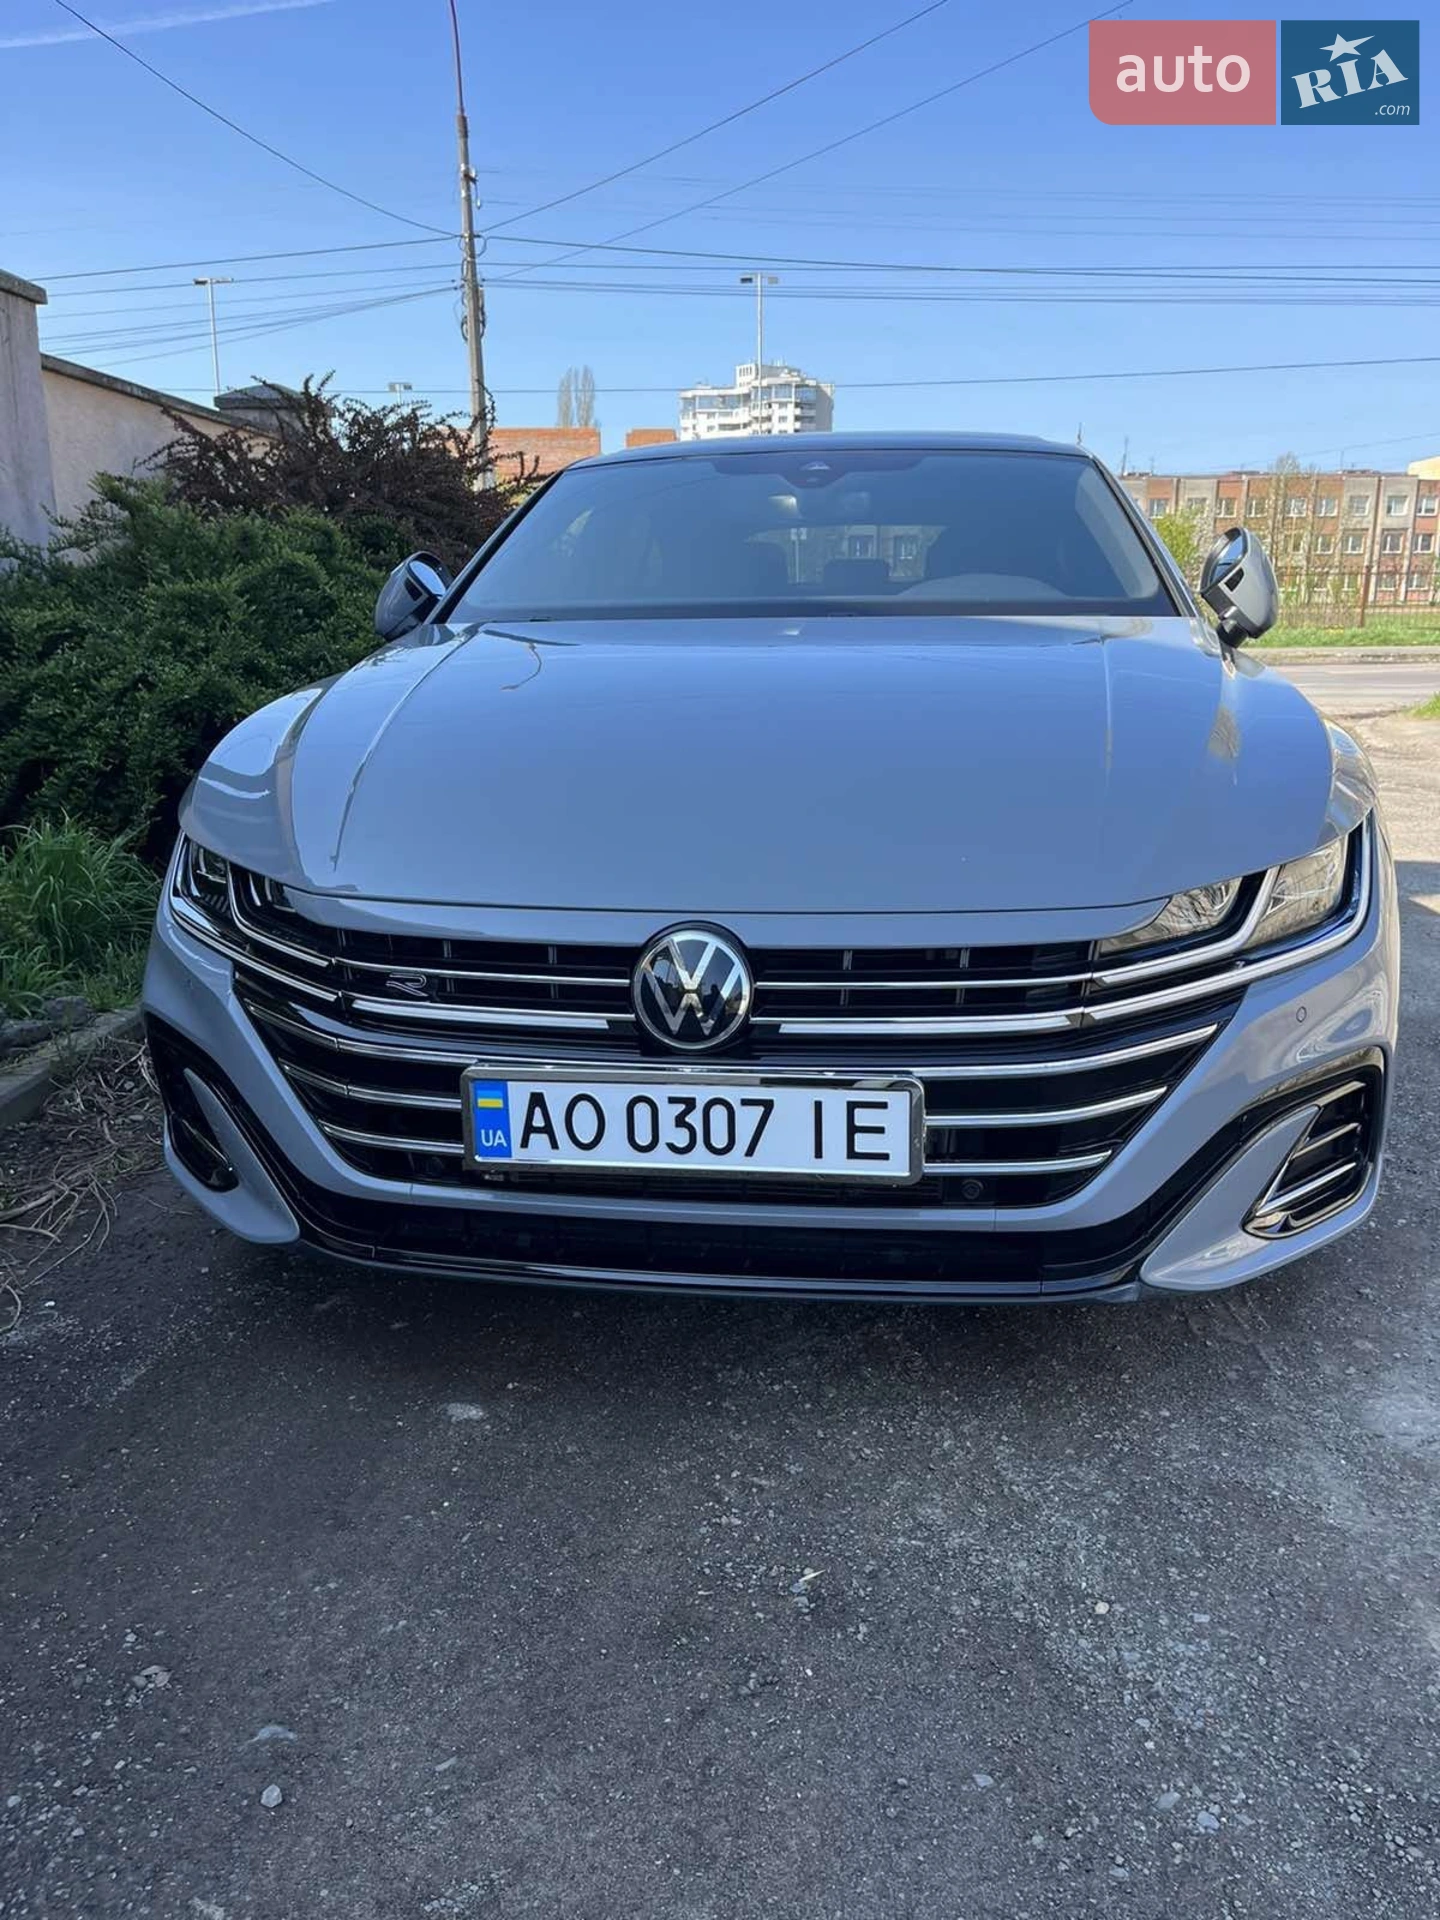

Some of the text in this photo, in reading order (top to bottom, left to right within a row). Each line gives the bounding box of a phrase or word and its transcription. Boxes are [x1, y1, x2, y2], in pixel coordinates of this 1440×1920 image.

[481, 1128, 508, 1148] UA
[519, 1091, 891, 1161] AO 0307 IE
